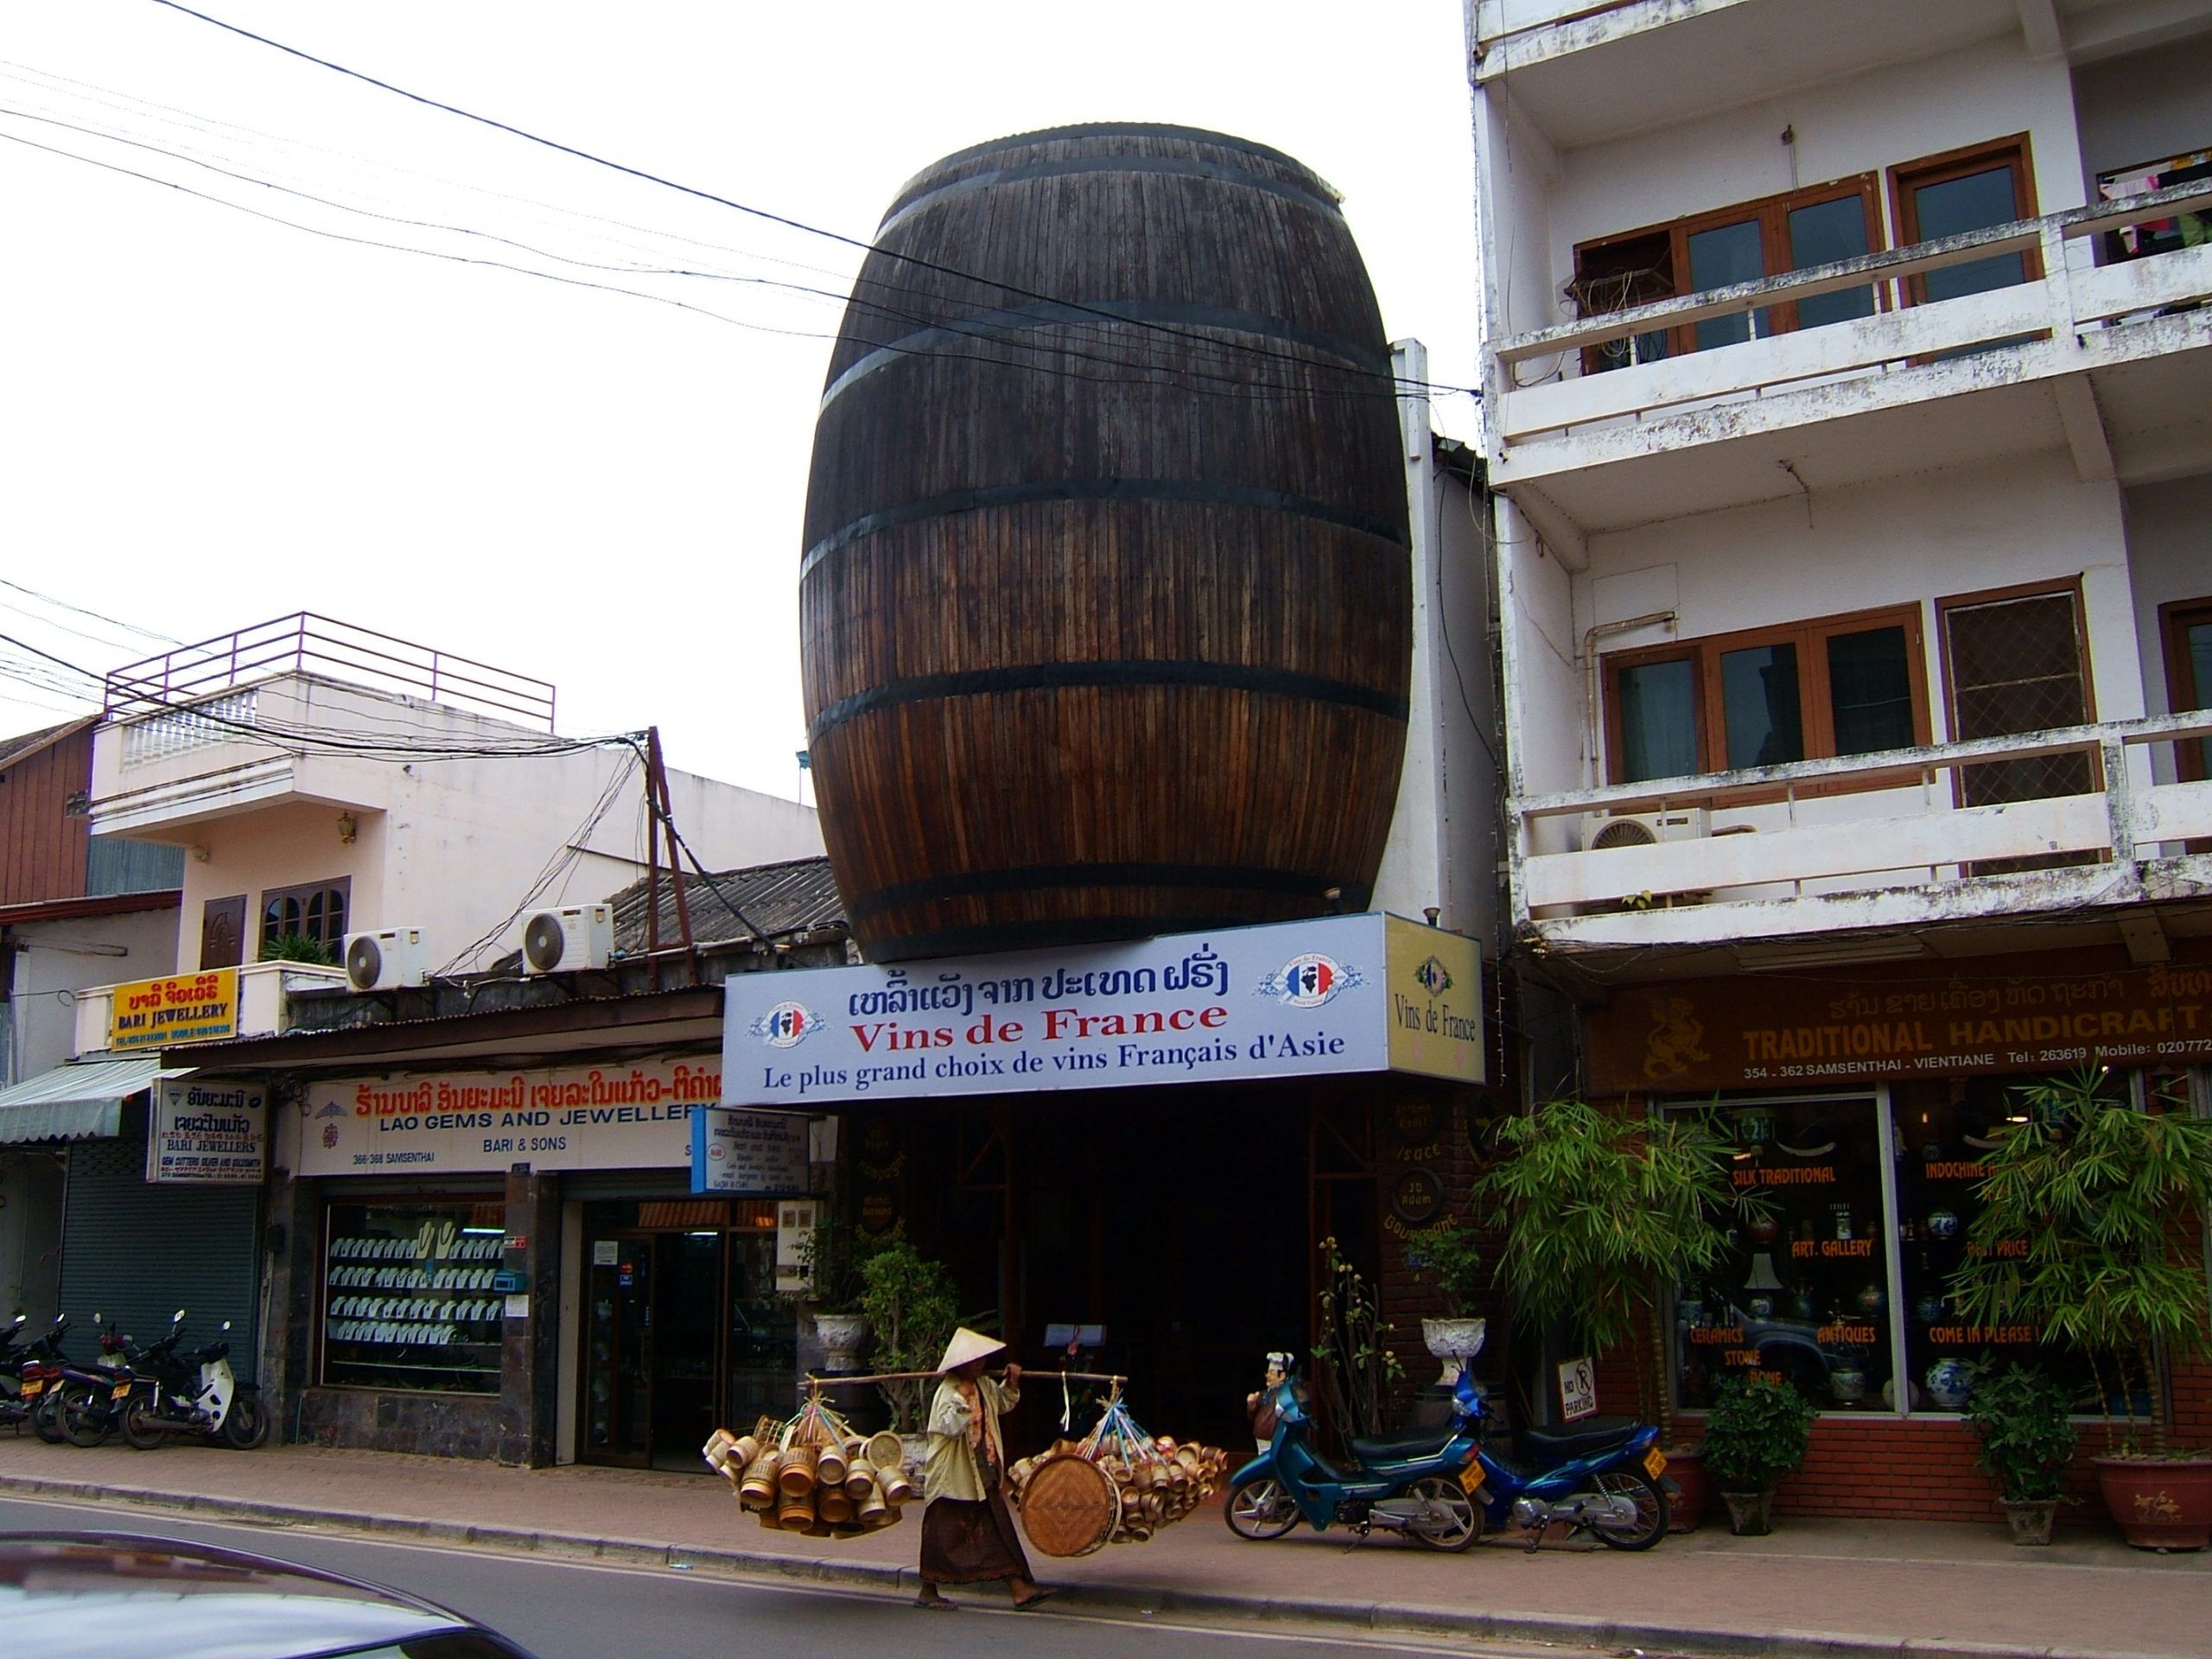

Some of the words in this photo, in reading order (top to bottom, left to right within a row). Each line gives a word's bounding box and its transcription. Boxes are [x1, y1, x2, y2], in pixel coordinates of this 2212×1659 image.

[118, 1013, 146, 1030] BARI
[151, 1003, 228, 1028] JEWELLERY
[1395, 994, 1421, 1030] Vins
[1426, 1000, 1438, 1033] de
[1442, 1004, 1475, 1042] France
[849, 1021, 954, 1052] Vins
[966, 1014, 1024, 1045] de
[1040, 1006, 1228, 1040] France
[1743, 1021, 1933, 1061] TRADITIONAL
[764, 1067, 791, 1089] Le
[798, 1065, 847, 1094] plus
[855, 1058, 926, 1090] grand
[935, 1053, 1004, 1078] choix
[1012, 1051, 1044, 1073] de
[1052, 1046, 1108, 1071] vins
[1117, 1038, 1236, 1070] Français
[1249, 1031, 1344, 1059] d'Asie
[1744, 1067, 1767, 1079] 354
[1780, 1065, 1804, 1077] 362
[1806, 1058, 1902, 1077] SAMSENTHAI
[1914, 1052, 1995, 1070] VIENTIANE
[2006, 1050, 2036, 1065] Tel:
[2040, 1046, 2087, 1063] 263619
[2094, 1042, 2152, 1059] Mobile:
[379, 1117, 418, 1132] LAO
[424, 1113, 493, 1130] GEMS
[501, 1110, 550, 1128] AND
[168, 1140, 192, 1152] BARI
[196, 1140, 257, 1154] JEWELLERS
[483, 1138, 512, 1154] BARI
[518, 1139, 526, 1152] &
[531, 1136, 566, 1151] SONS
[385, 1152, 435, 1164] SAMSENTHAI
[1732, 1168, 1757, 1186] SILK
[1758, 1166, 1837, 1185] TRADITIONAL
[1926, 1161, 1986, 1179] INDOCHINE
[1821, 1238, 1873, 1258] GALLERY
[1997, 1238, 2030, 1258] PRICE
[1689, 1327, 1745, 1345] CERAMICS
[1817, 1325, 1877, 1344] ANTIQUES
[1929, 1326, 1964, 1344] COME
[1967, 1325, 1981, 1344] IN
[1984, 1325, 2032, 1344] PLEASE
[1724, 1349, 1762, 1366] STONE
[1564, 1380, 1574, 1395] NO
[1566, 1395, 1593, 1416] PARKING
